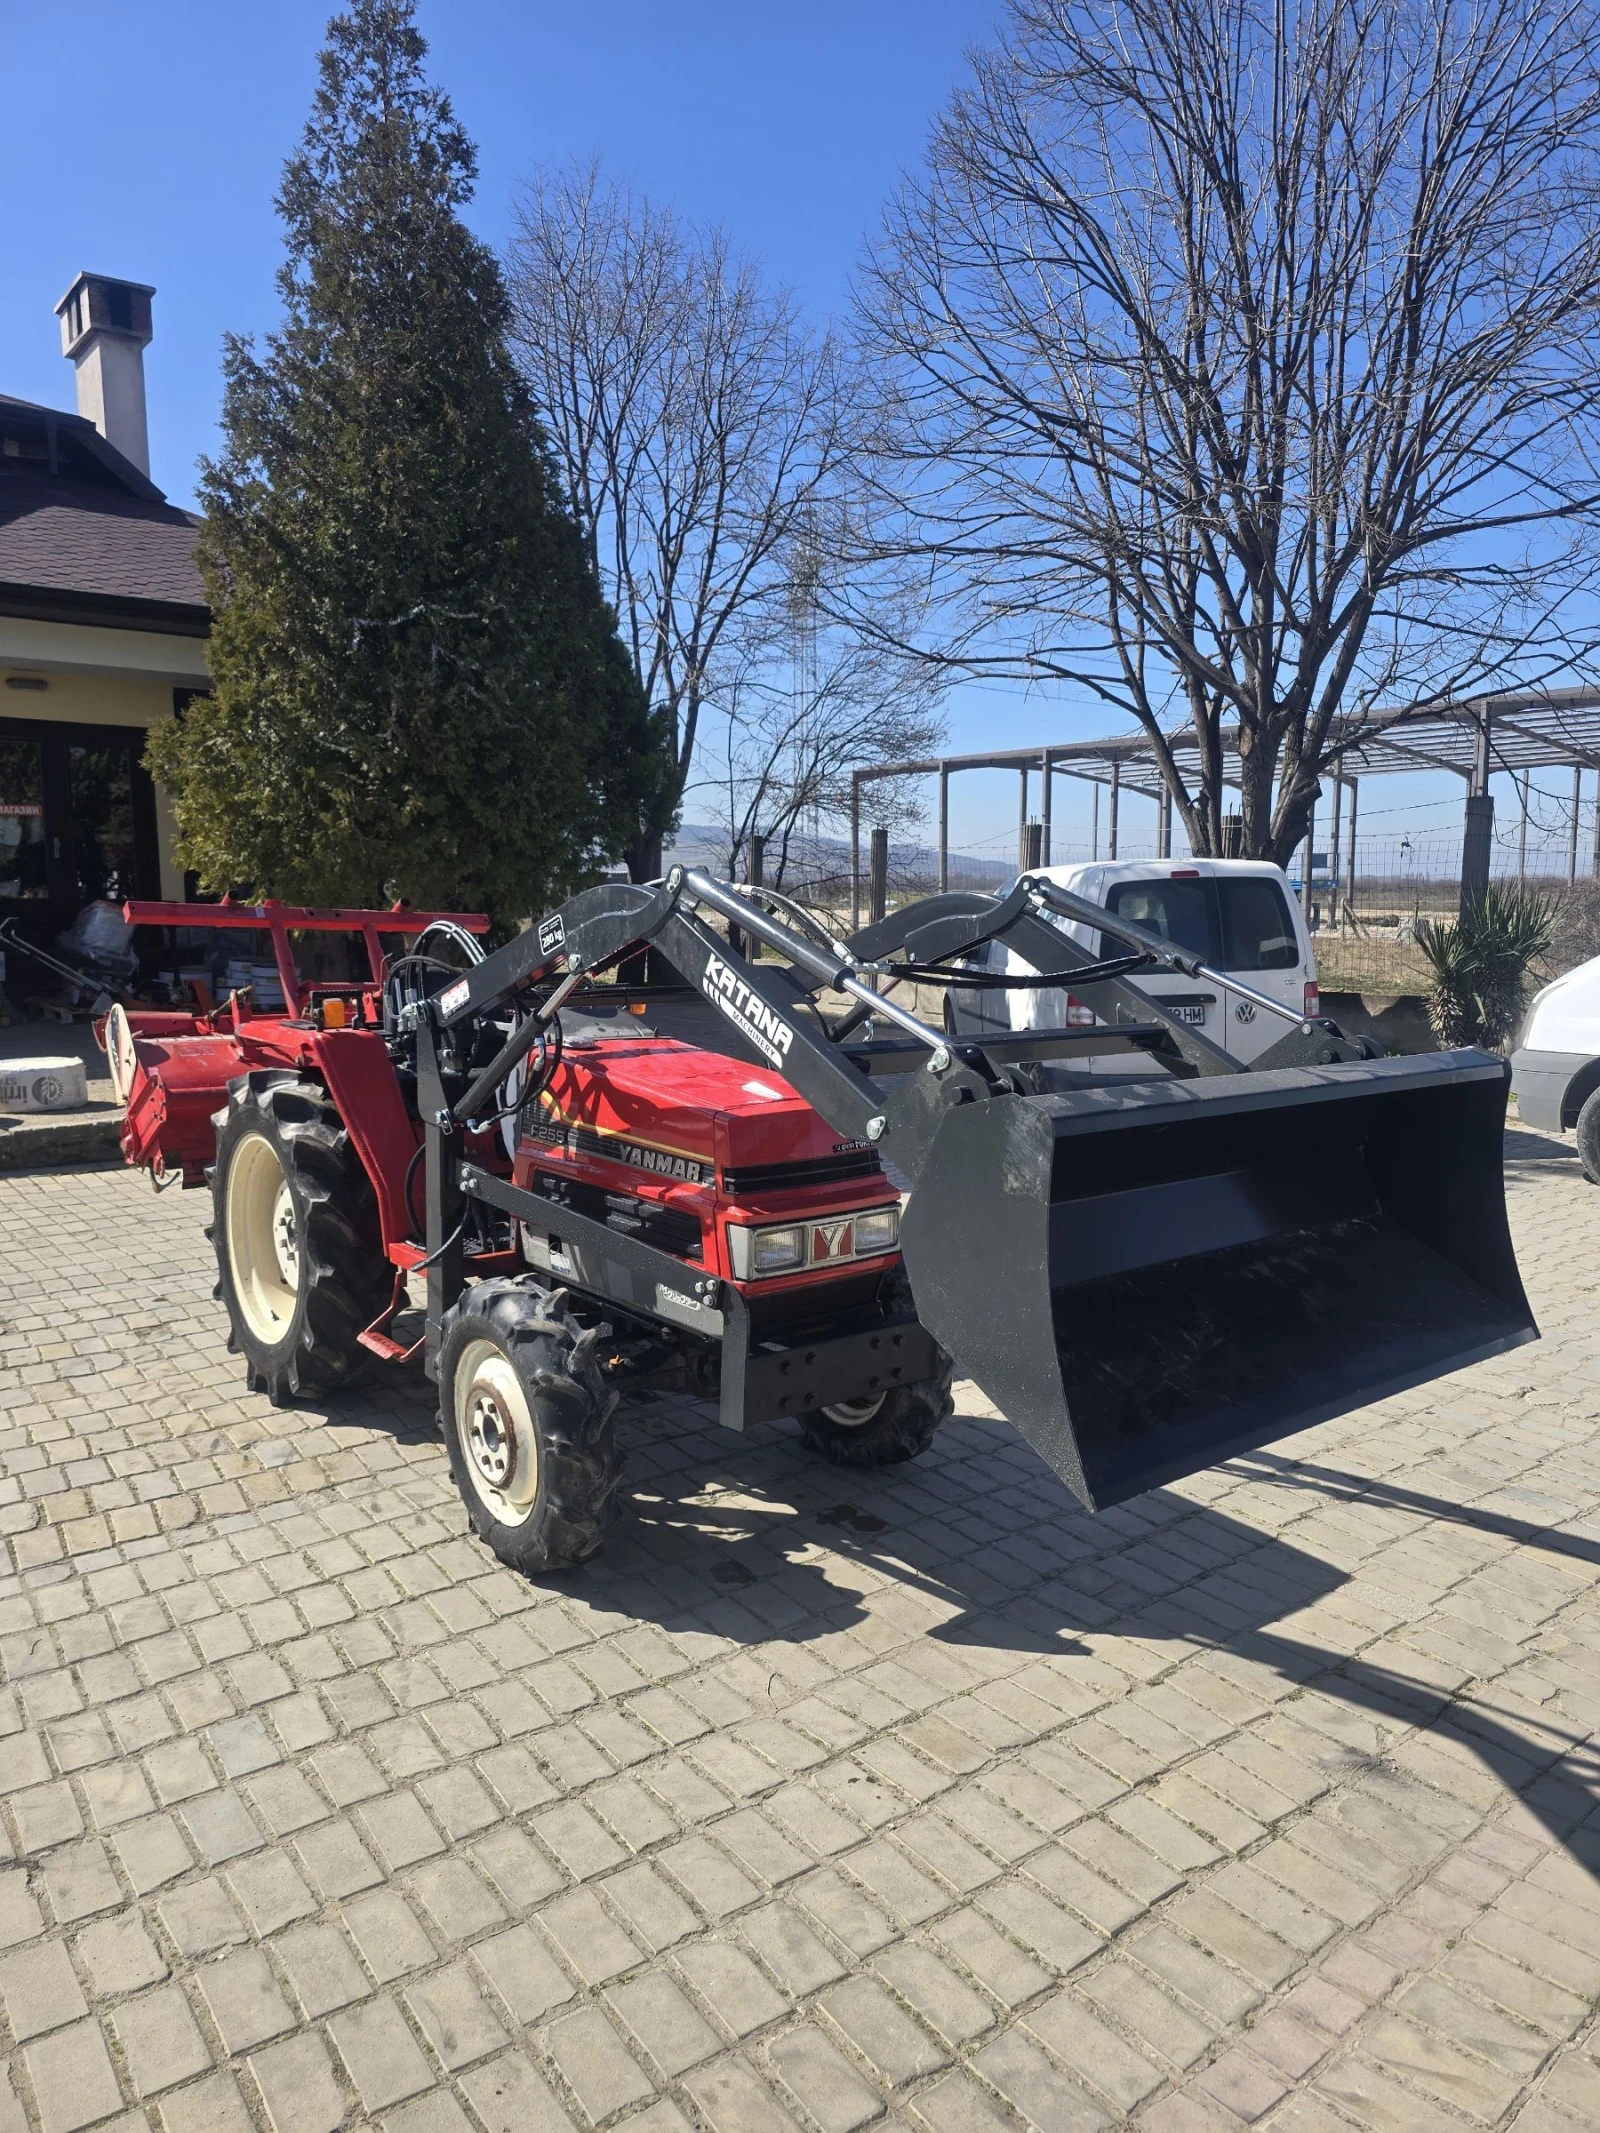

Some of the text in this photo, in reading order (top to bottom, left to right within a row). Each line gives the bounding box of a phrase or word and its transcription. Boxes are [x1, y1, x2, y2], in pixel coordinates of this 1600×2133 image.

[705, 953, 793, 1055] KATANA
[732, 1011, 775, 1057] MACHINERY
[530, 1124, 565, 1143] F255
[620, 1145, 700, 1180] YANMAR
